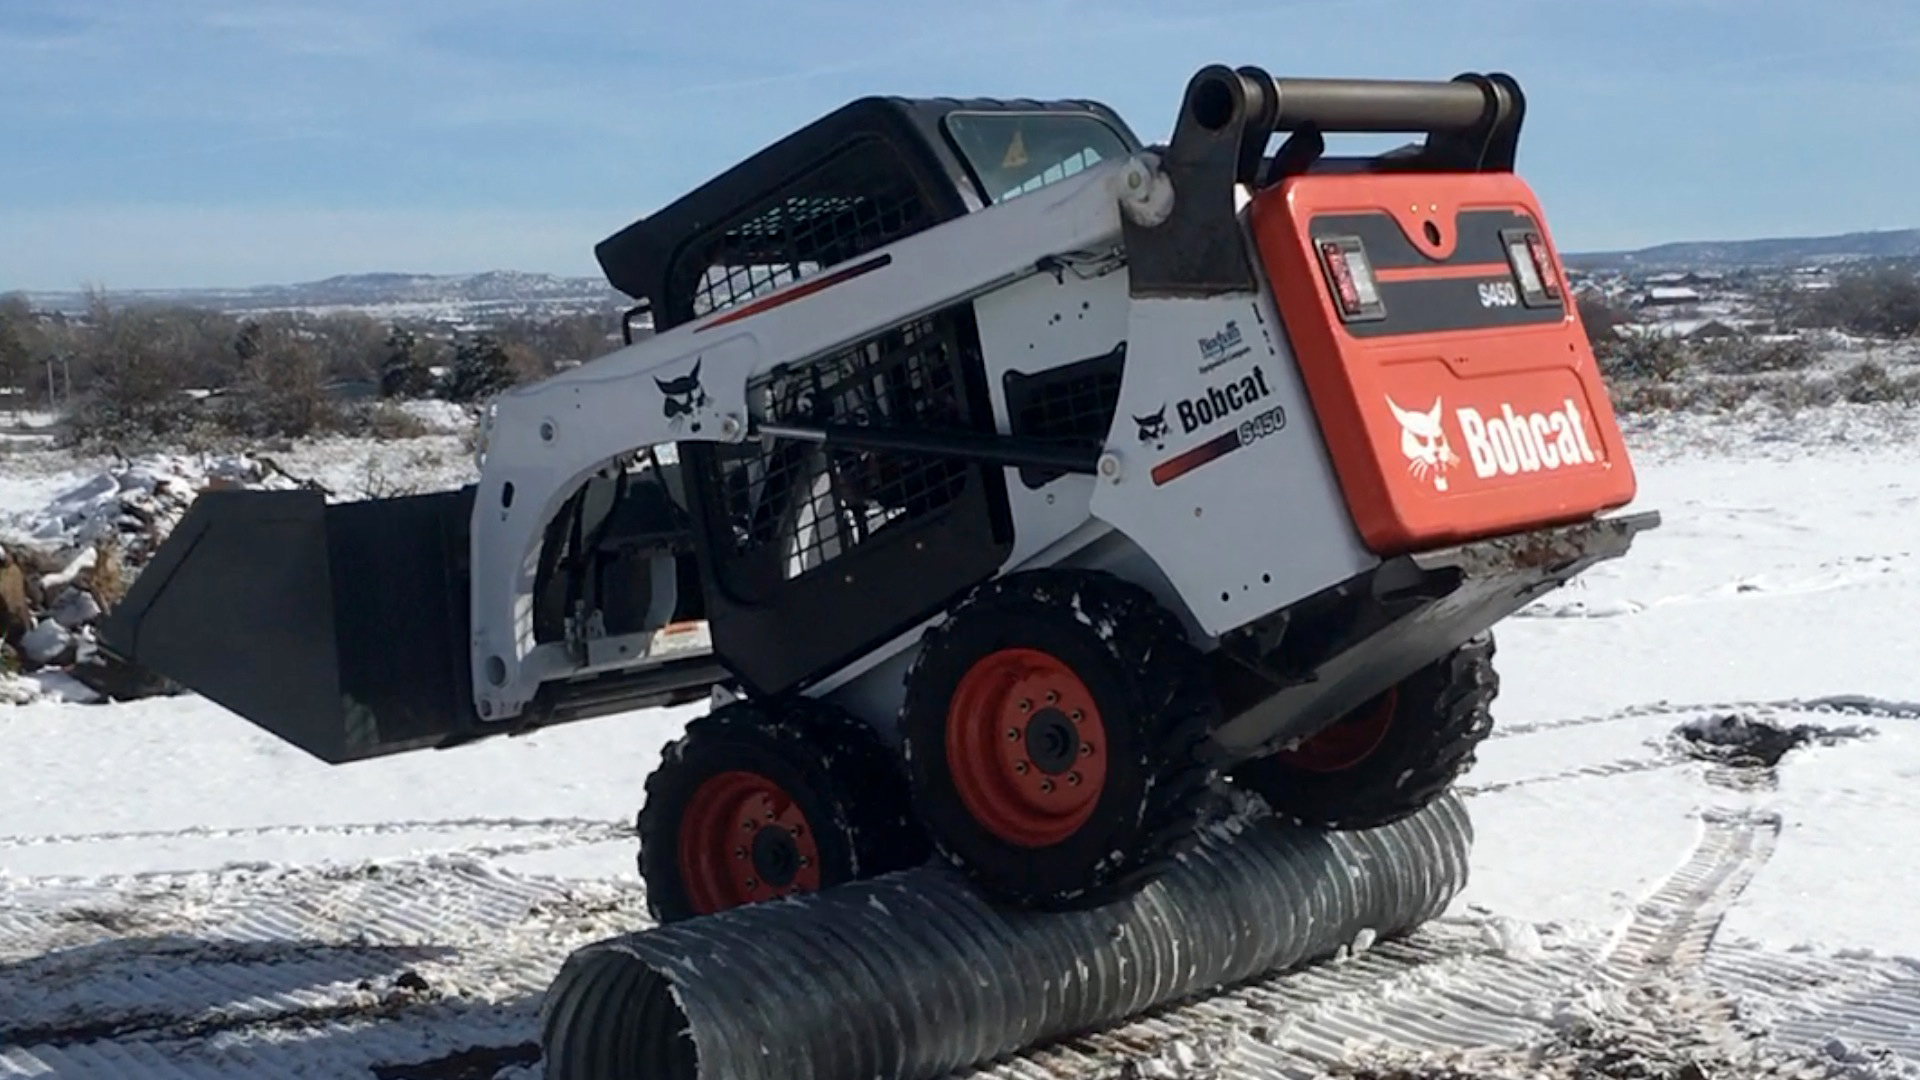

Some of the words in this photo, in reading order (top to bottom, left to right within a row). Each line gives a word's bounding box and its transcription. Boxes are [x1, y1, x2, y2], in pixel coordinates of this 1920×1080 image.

[1478, 282, 1517, 307] S450
[1176, 365, 1270, 433] Bobcat
[1239, 405, 1287, 446] S450
[1457, 399, 1595, 479] Bobcat
